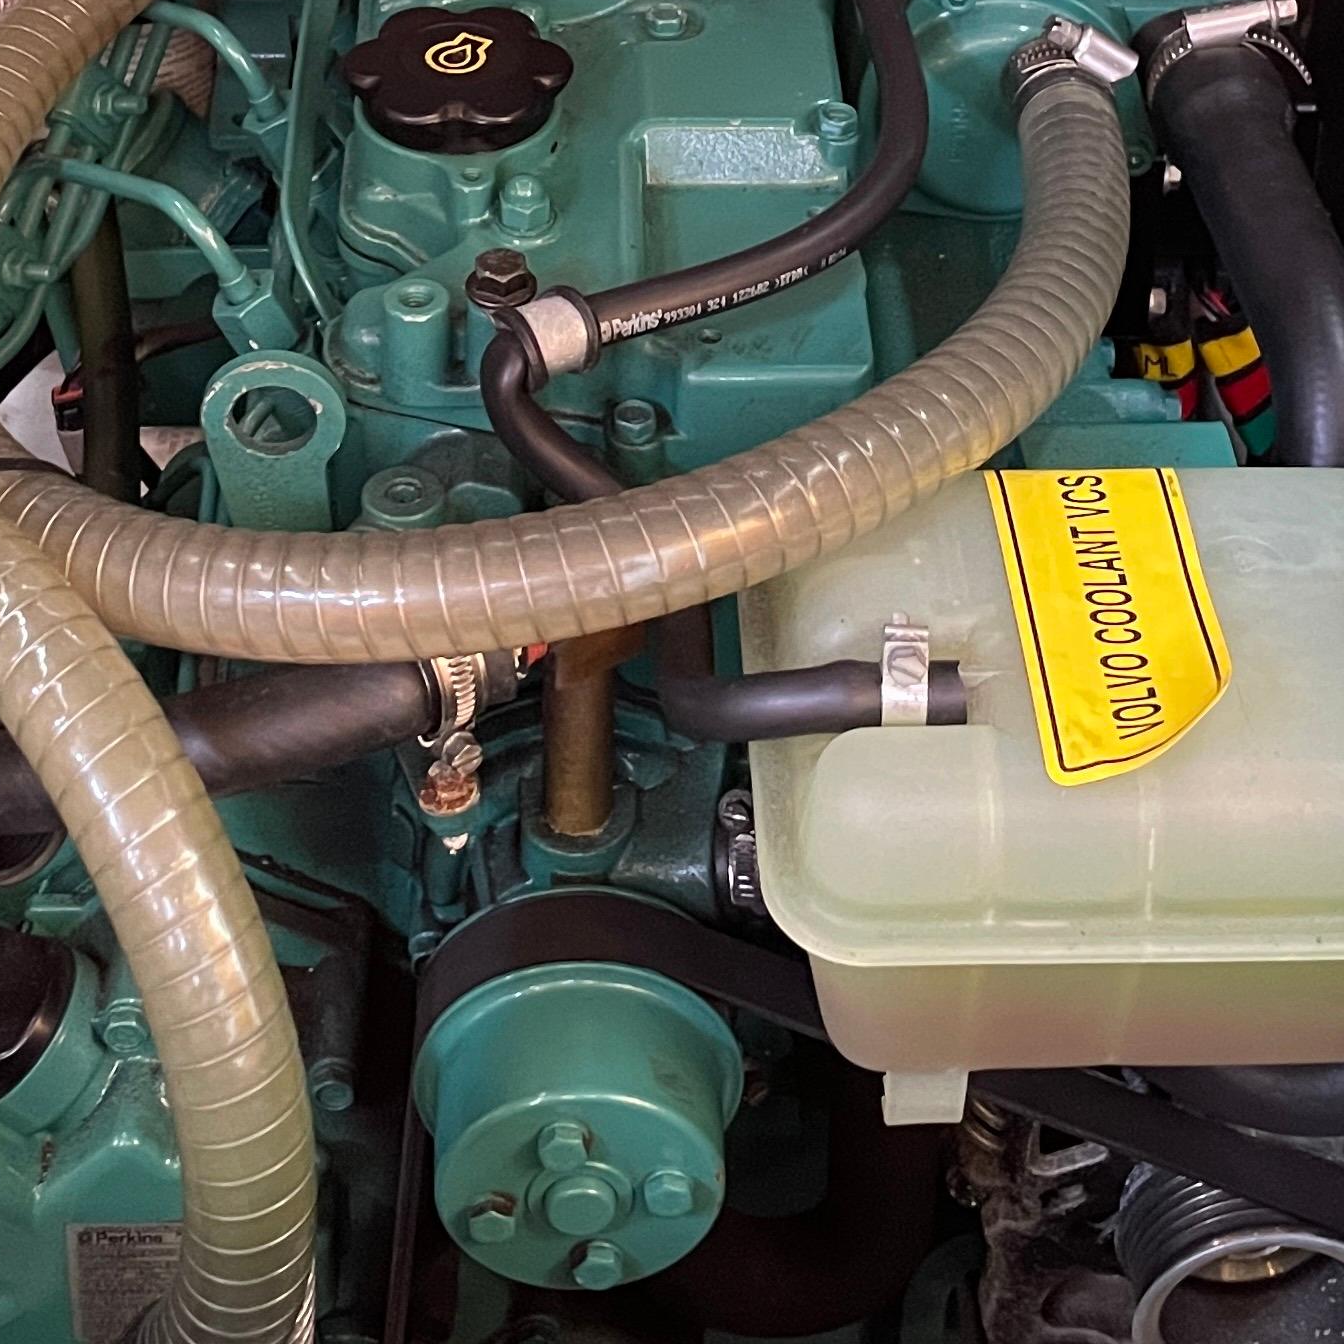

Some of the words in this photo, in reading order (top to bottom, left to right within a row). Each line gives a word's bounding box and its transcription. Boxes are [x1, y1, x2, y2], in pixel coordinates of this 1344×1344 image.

[612, 308, 661, 340] Perkins
[1056, 474, 1110, 520] VCS
[1068, 525, 1143, 645] COOLANT
[1099, 652, 1165, 741] VOLVO
